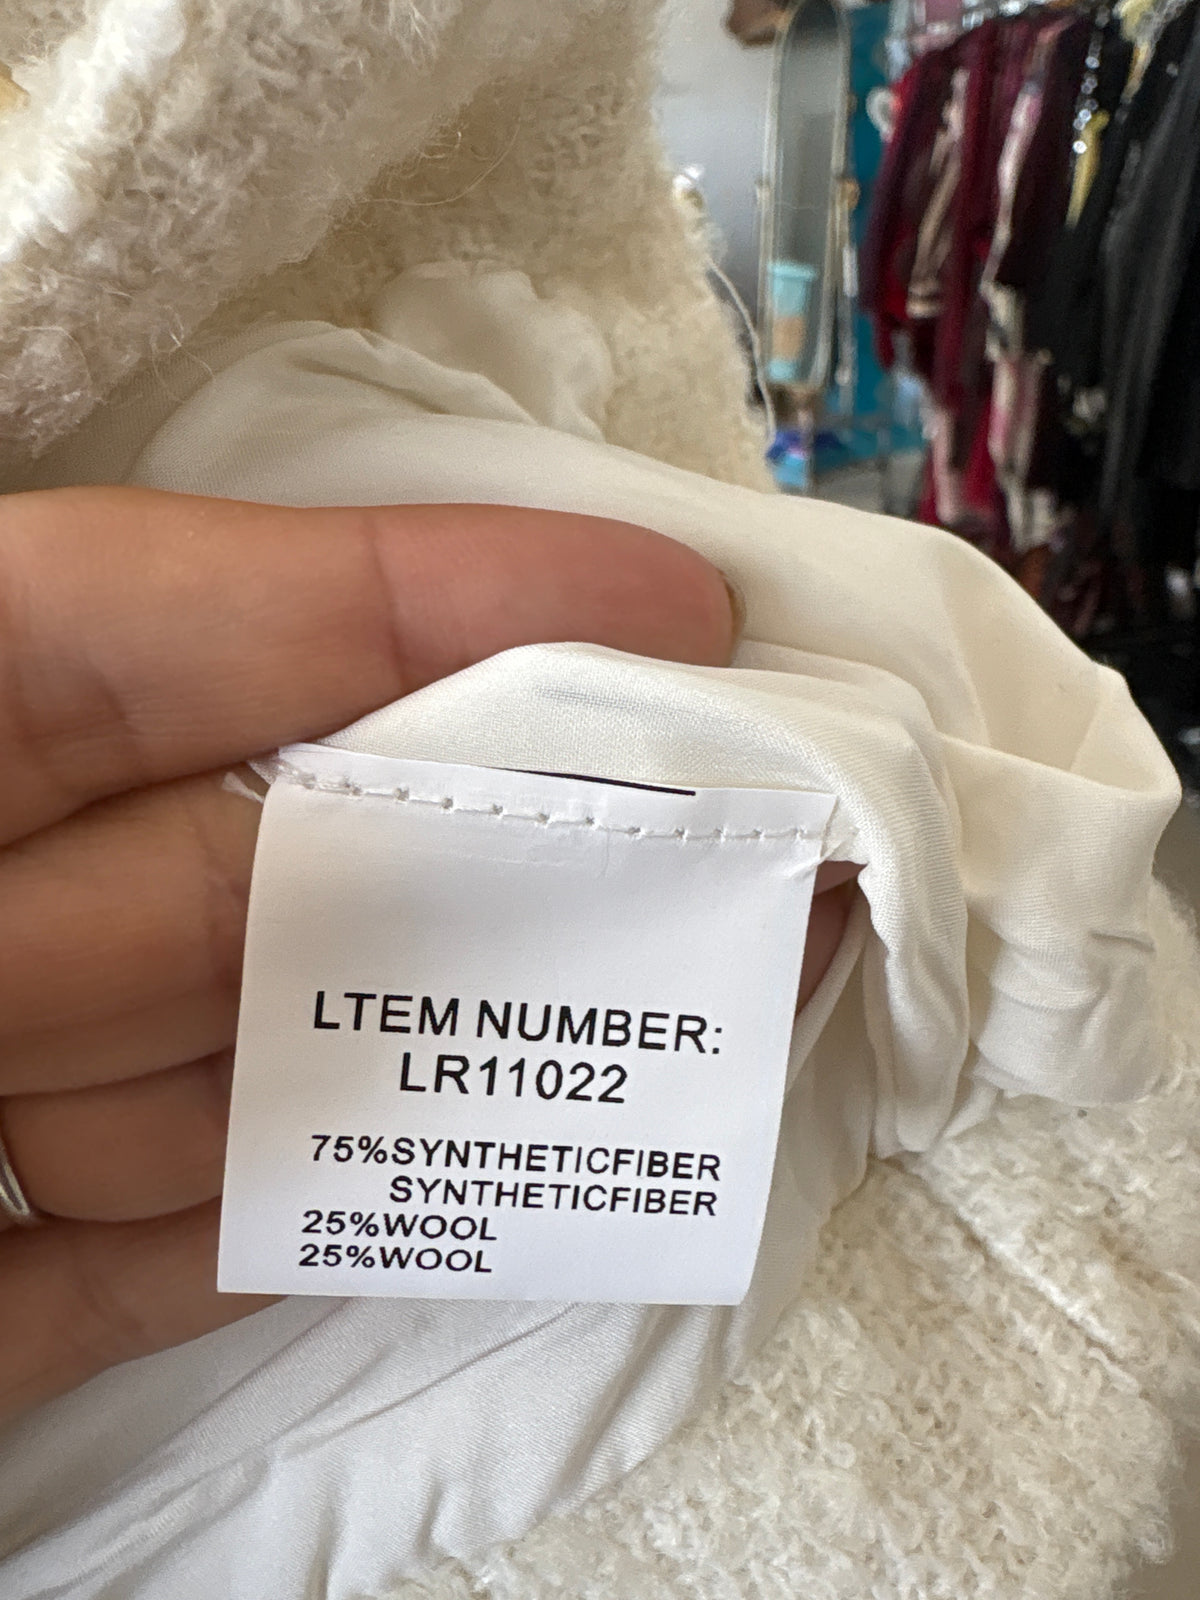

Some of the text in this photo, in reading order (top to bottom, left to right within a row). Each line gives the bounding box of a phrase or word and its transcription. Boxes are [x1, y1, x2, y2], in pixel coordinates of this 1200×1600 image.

[313, 990, 722, 1055] LTEM NUMBER:
[399, 1052, 628, 1104] LR11022
[311, 1134, 721, 1182] 75%SYNTHETICFIBER
[389, 1175, 717, 1217] SYNTHETICFIBER
[301, 1209, 497, 1241] 25%WOOL
[298, 1243, 492, 1273] 25%WOOL
